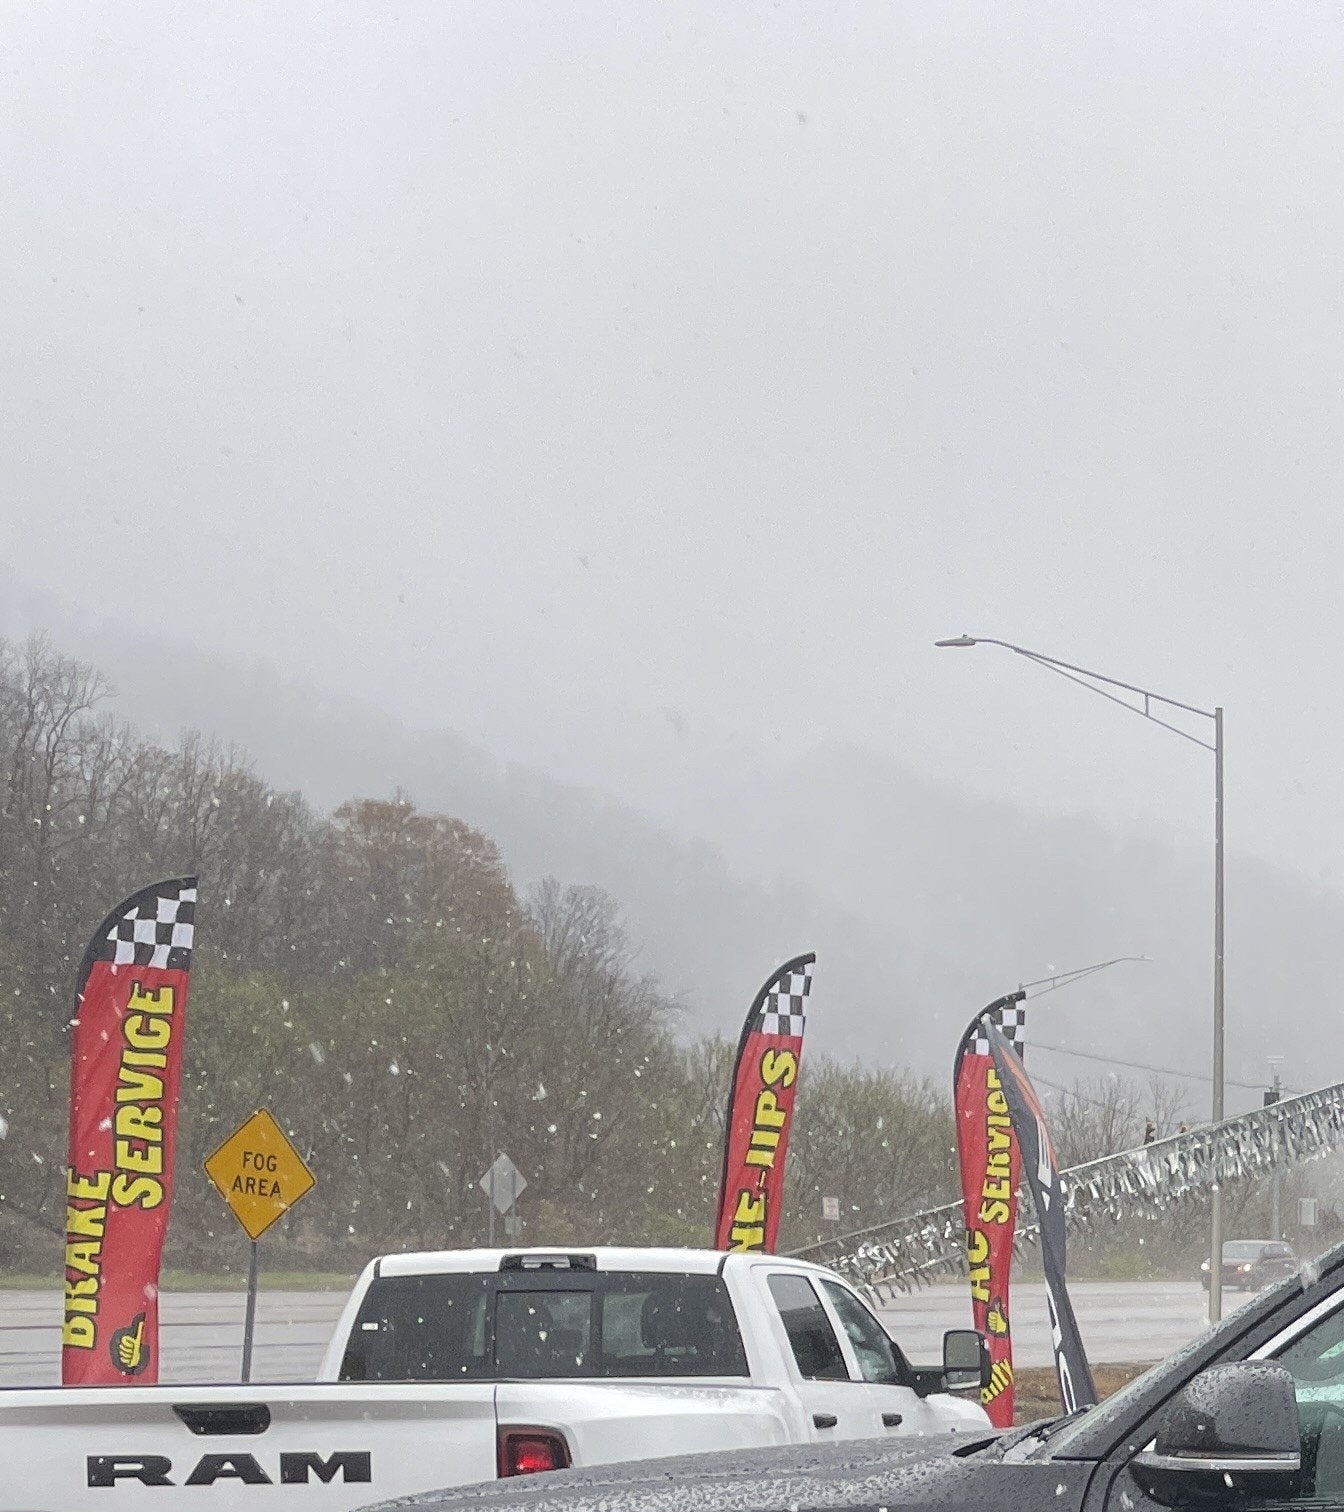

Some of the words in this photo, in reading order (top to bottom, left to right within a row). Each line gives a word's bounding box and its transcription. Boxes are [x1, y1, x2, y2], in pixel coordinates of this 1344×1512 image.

[111, 982, 175, 1210] SERVICE
[242, 1150, 278, 1173] FOG
[231, 1174, 283, 1199] AREA
[61, 1167, 112, 1349] BRAKE
[87, 1451, 372, 1488] RAM
